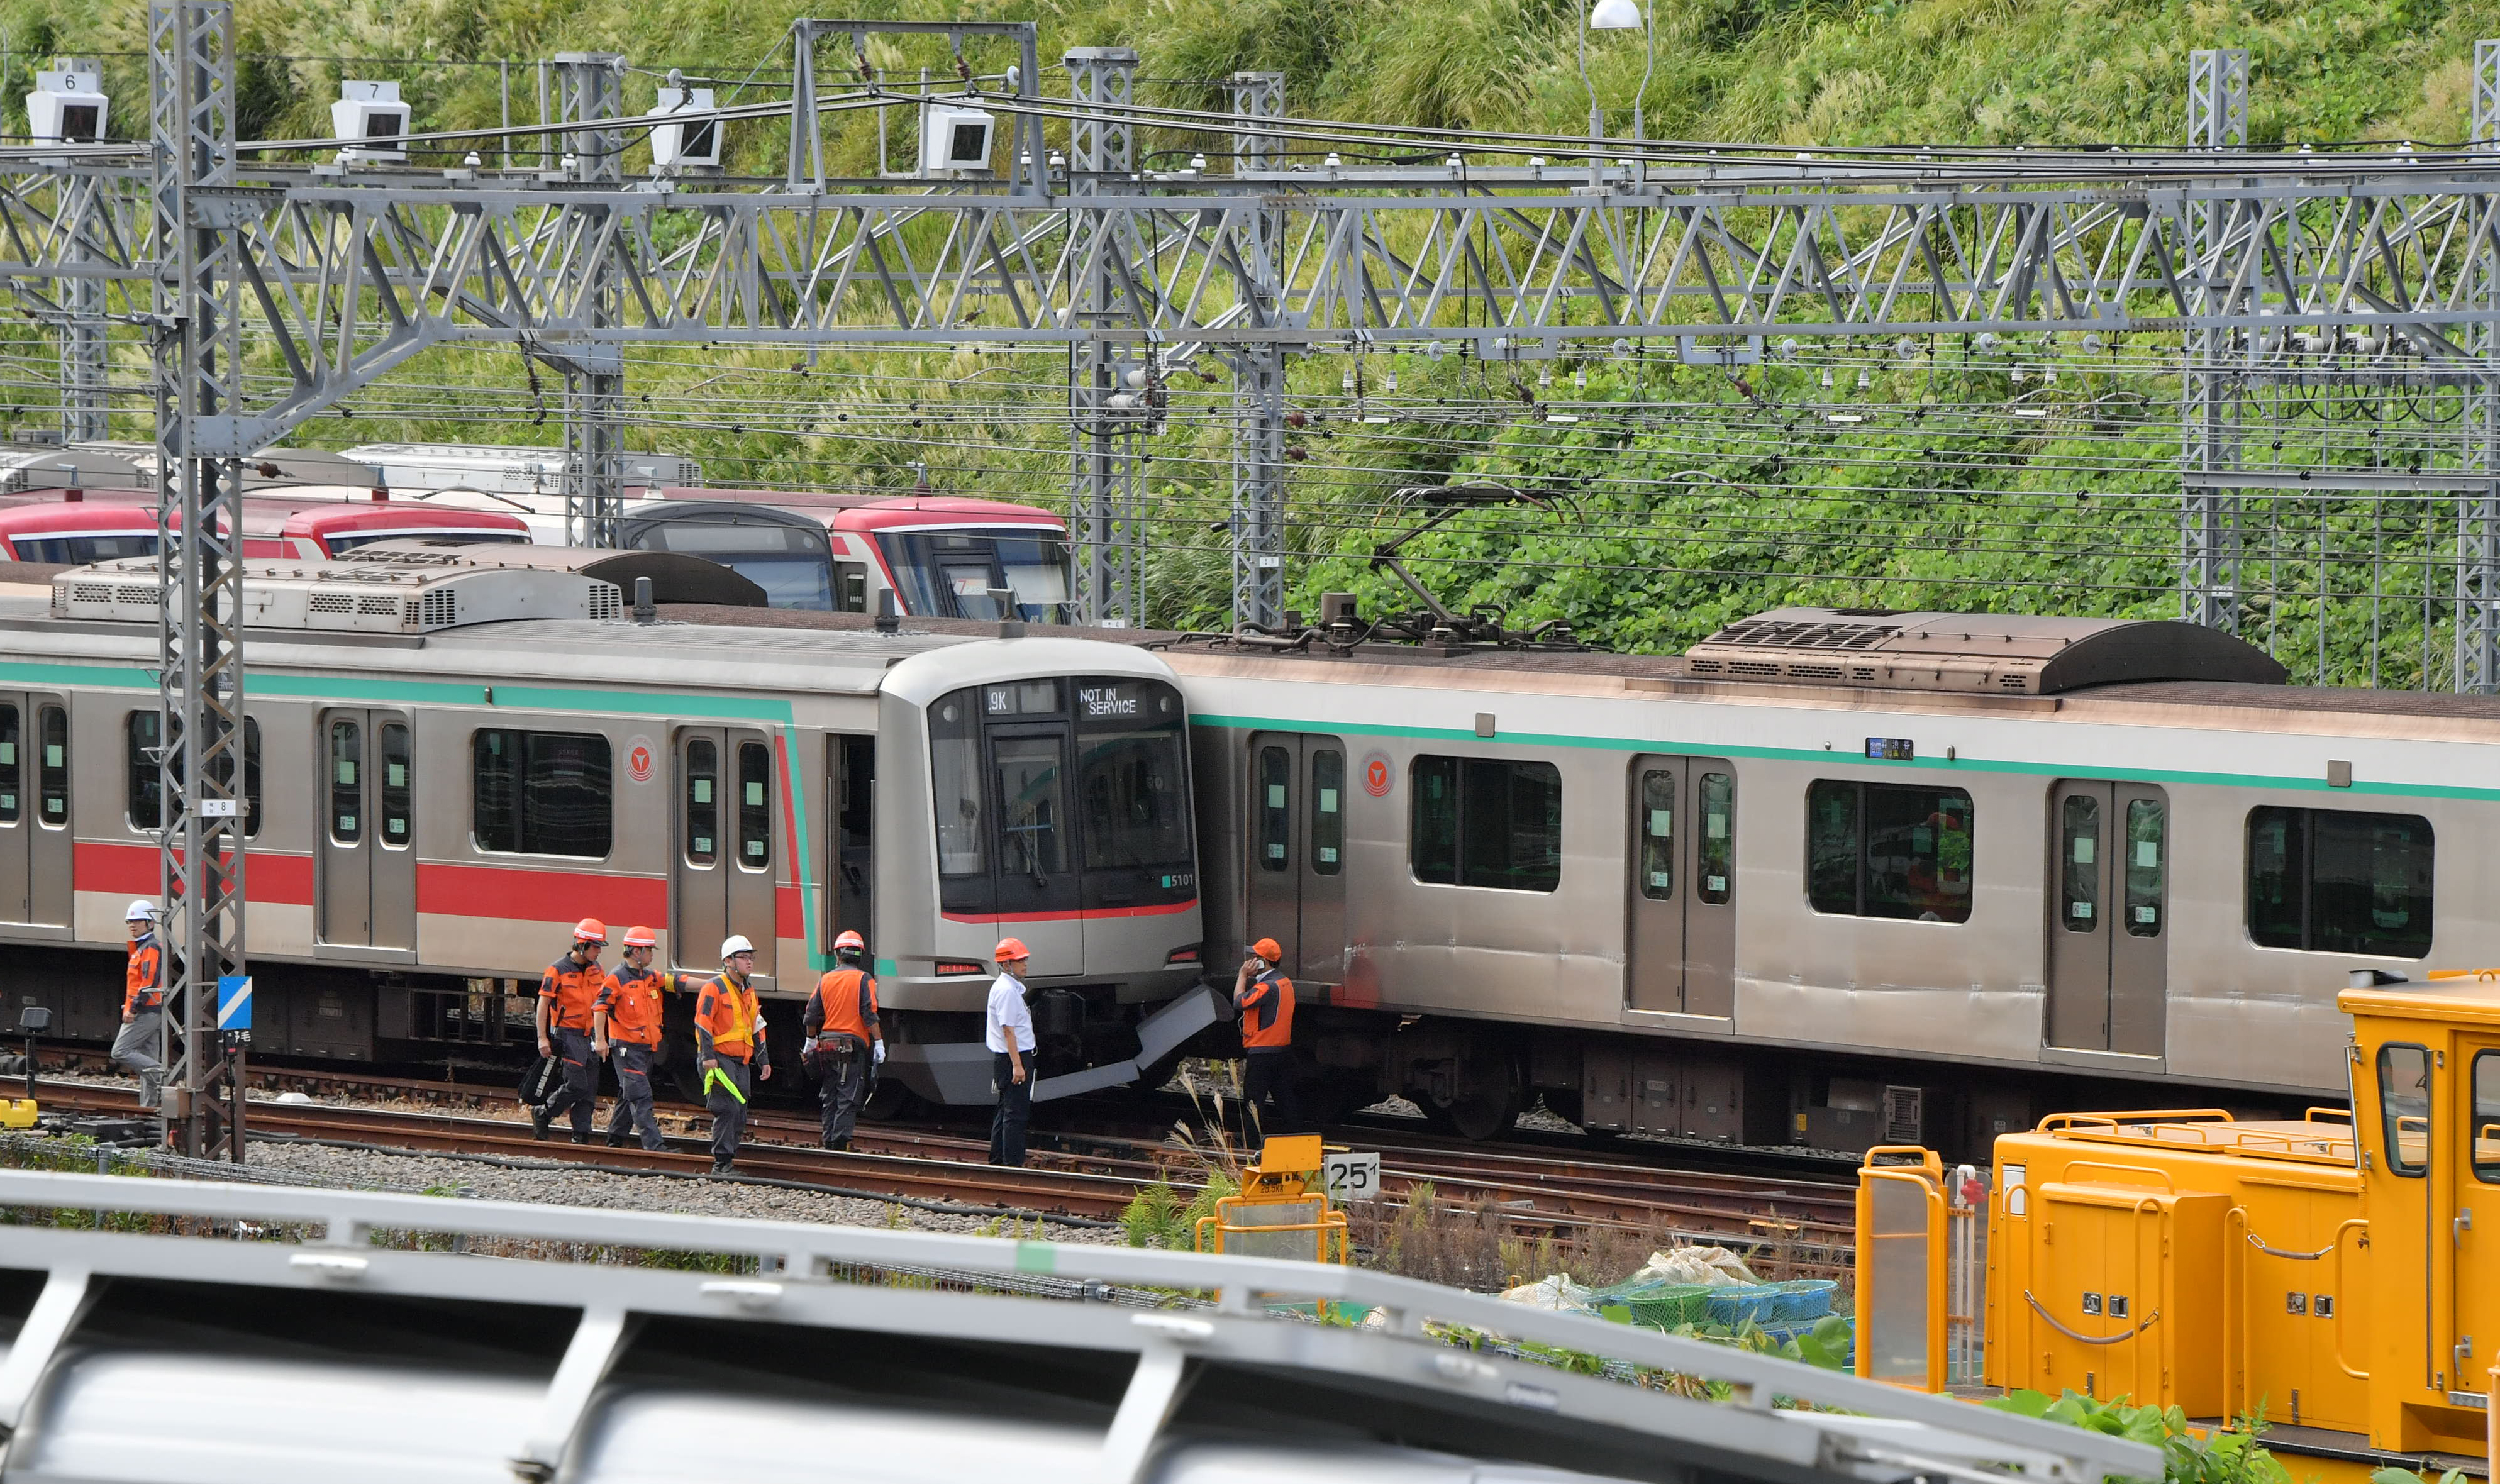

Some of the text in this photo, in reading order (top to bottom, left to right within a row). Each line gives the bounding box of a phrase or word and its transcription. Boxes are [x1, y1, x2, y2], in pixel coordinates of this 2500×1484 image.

[65, 74, 75, 89] 6
[370, 83, 379, 99] 7
[958, 579, 967, 594] 7
[218, 681, 234, 690] ERVIC
[1080, 688, 1116, 702] NOT IN
[1089, 700, 1136, 715] SERVICE
[221, 802, 226, 811] 8
[1172, 873, 1193, 887] 5101
